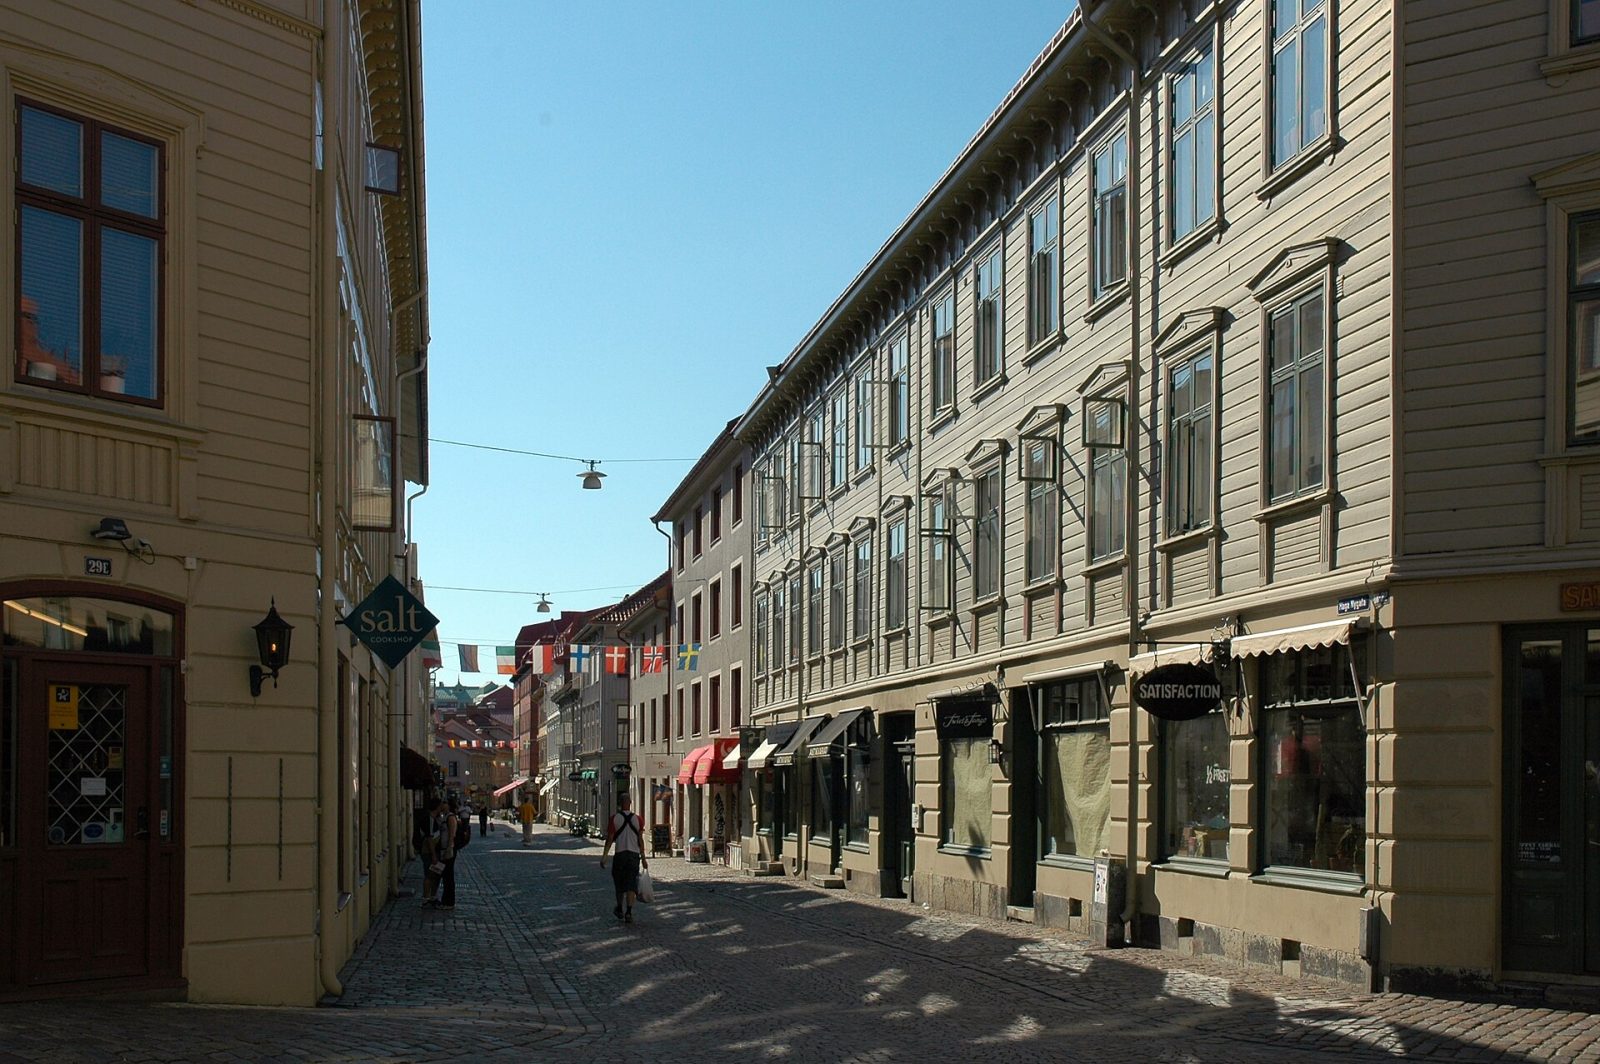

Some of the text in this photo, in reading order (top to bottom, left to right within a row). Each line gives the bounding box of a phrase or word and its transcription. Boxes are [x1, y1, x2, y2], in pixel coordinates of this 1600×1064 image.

[88, 560, 109, 574] 29E
[360, 595, 423, 632] salt
[1139, 684, 1221, 699] SATISFACTION
